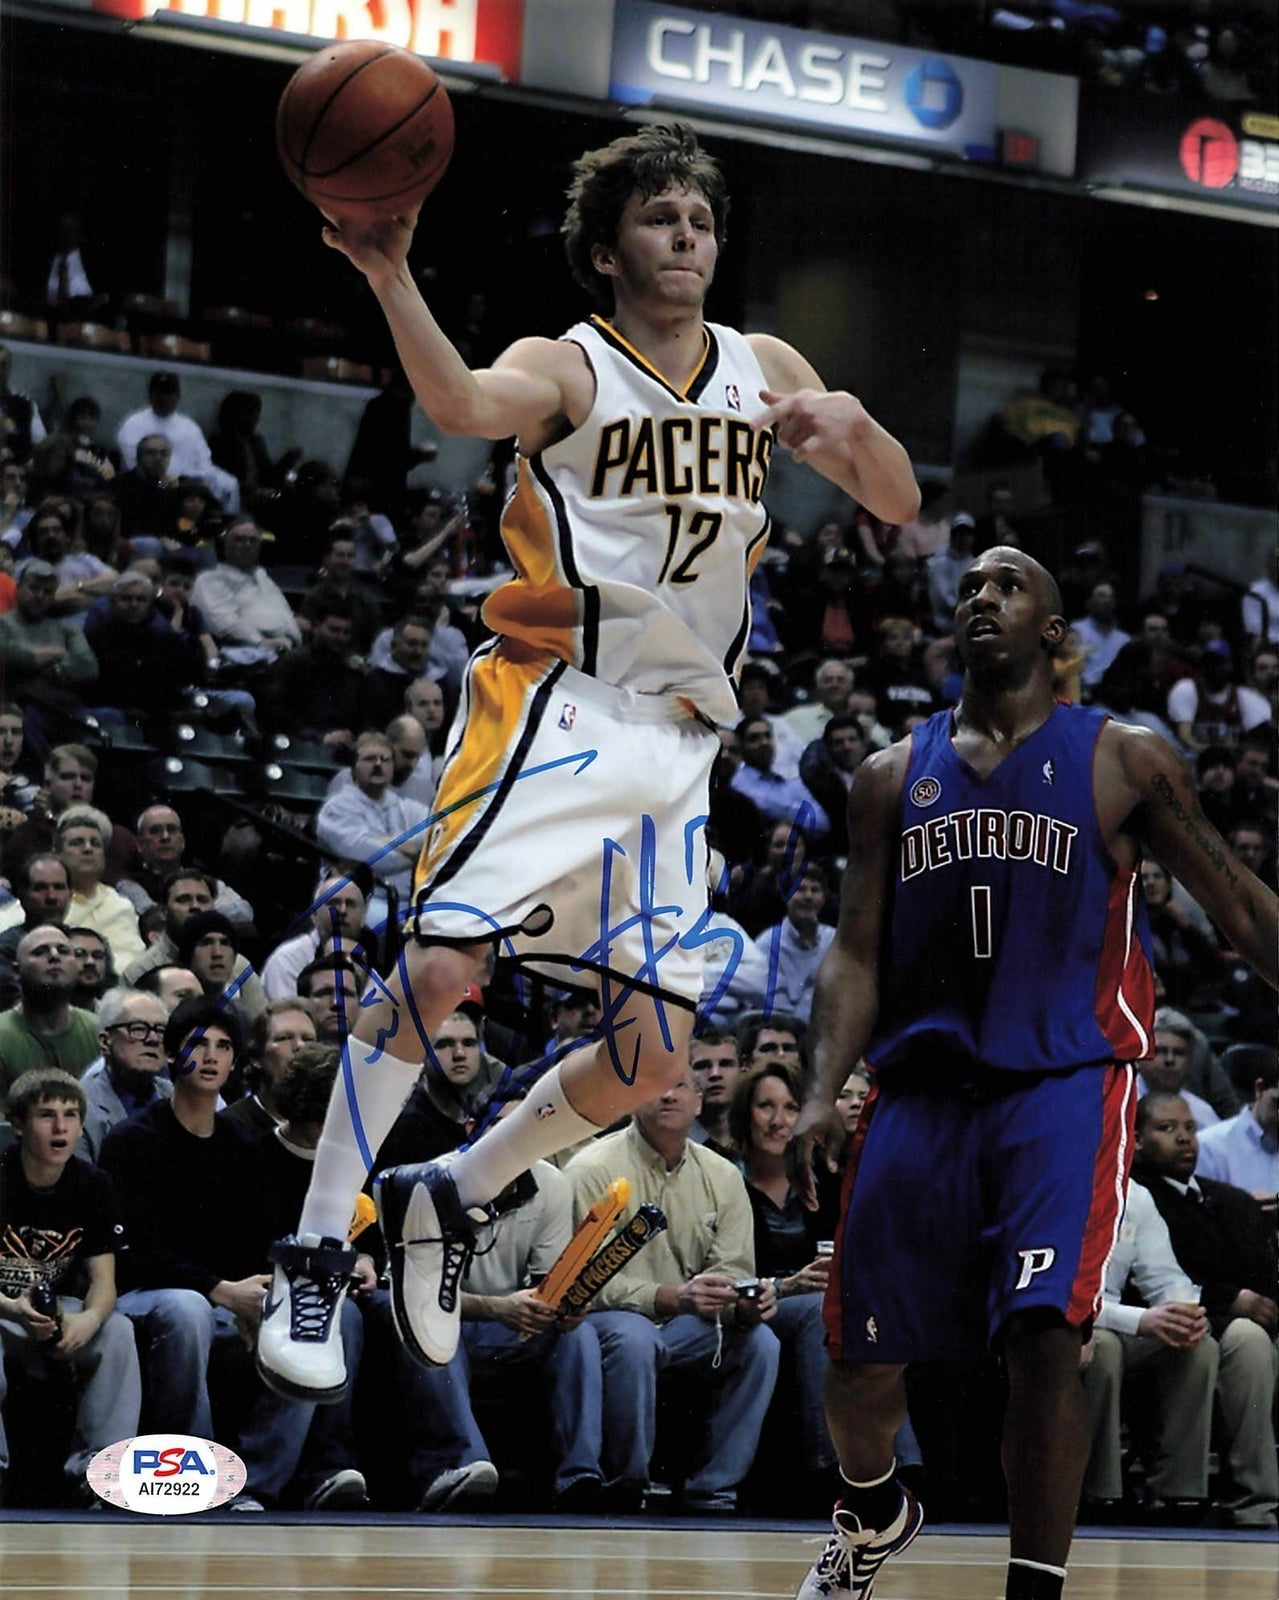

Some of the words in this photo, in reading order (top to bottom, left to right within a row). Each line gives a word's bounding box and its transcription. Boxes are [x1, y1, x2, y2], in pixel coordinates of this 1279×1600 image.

[142, 0, 477, 62] RSH
[649, 17, 892, 113] CHASE
[590, 414, 773, 505] PACERS
[655, 503, 725, 586] 12
[901, 809, 1078, 882] DETROIT
[970, 885, 992, 958] 1
[1014, 1246, 1056, 1290] P
